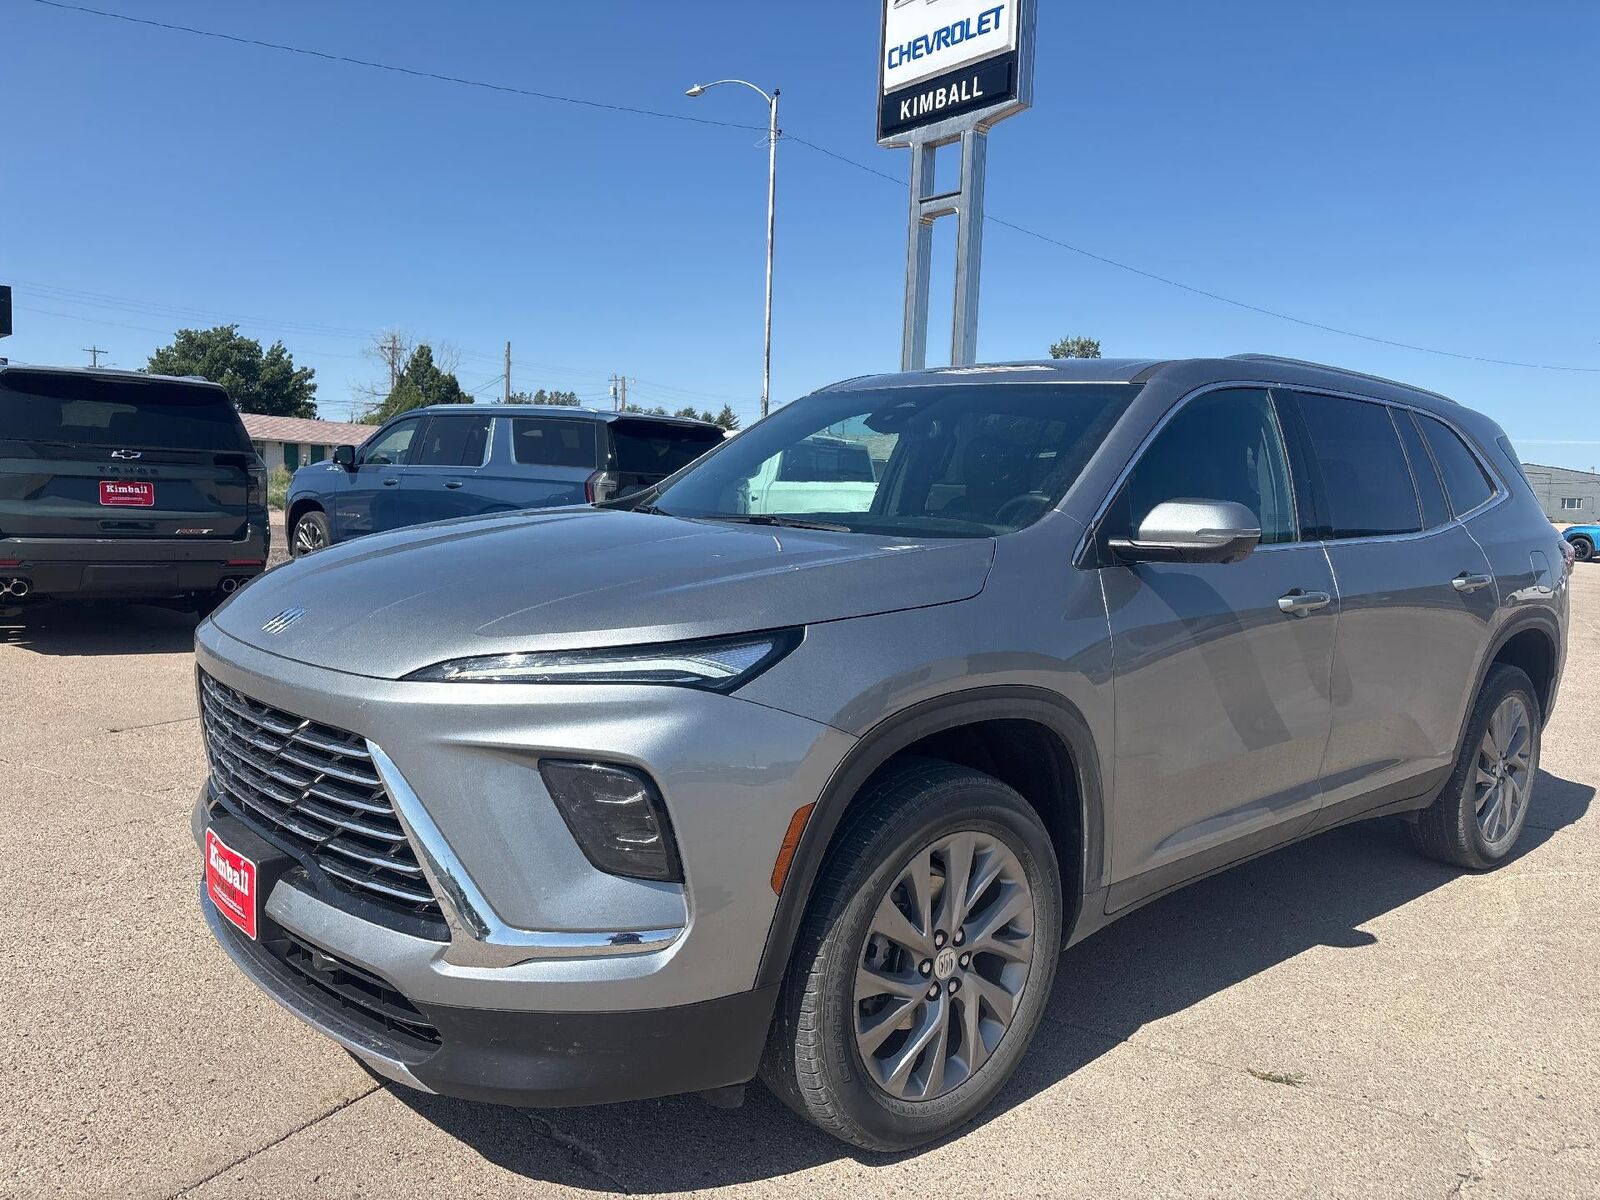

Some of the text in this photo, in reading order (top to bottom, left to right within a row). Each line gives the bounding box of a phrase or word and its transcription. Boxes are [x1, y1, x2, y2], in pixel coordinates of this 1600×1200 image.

[887, 4, 1005, 69] CHEVROLET
[900, 76, 984, 120] KIMBALL
[106, 484, 149, 494] Kimball
[209, 842, 249, 896] Kimball
